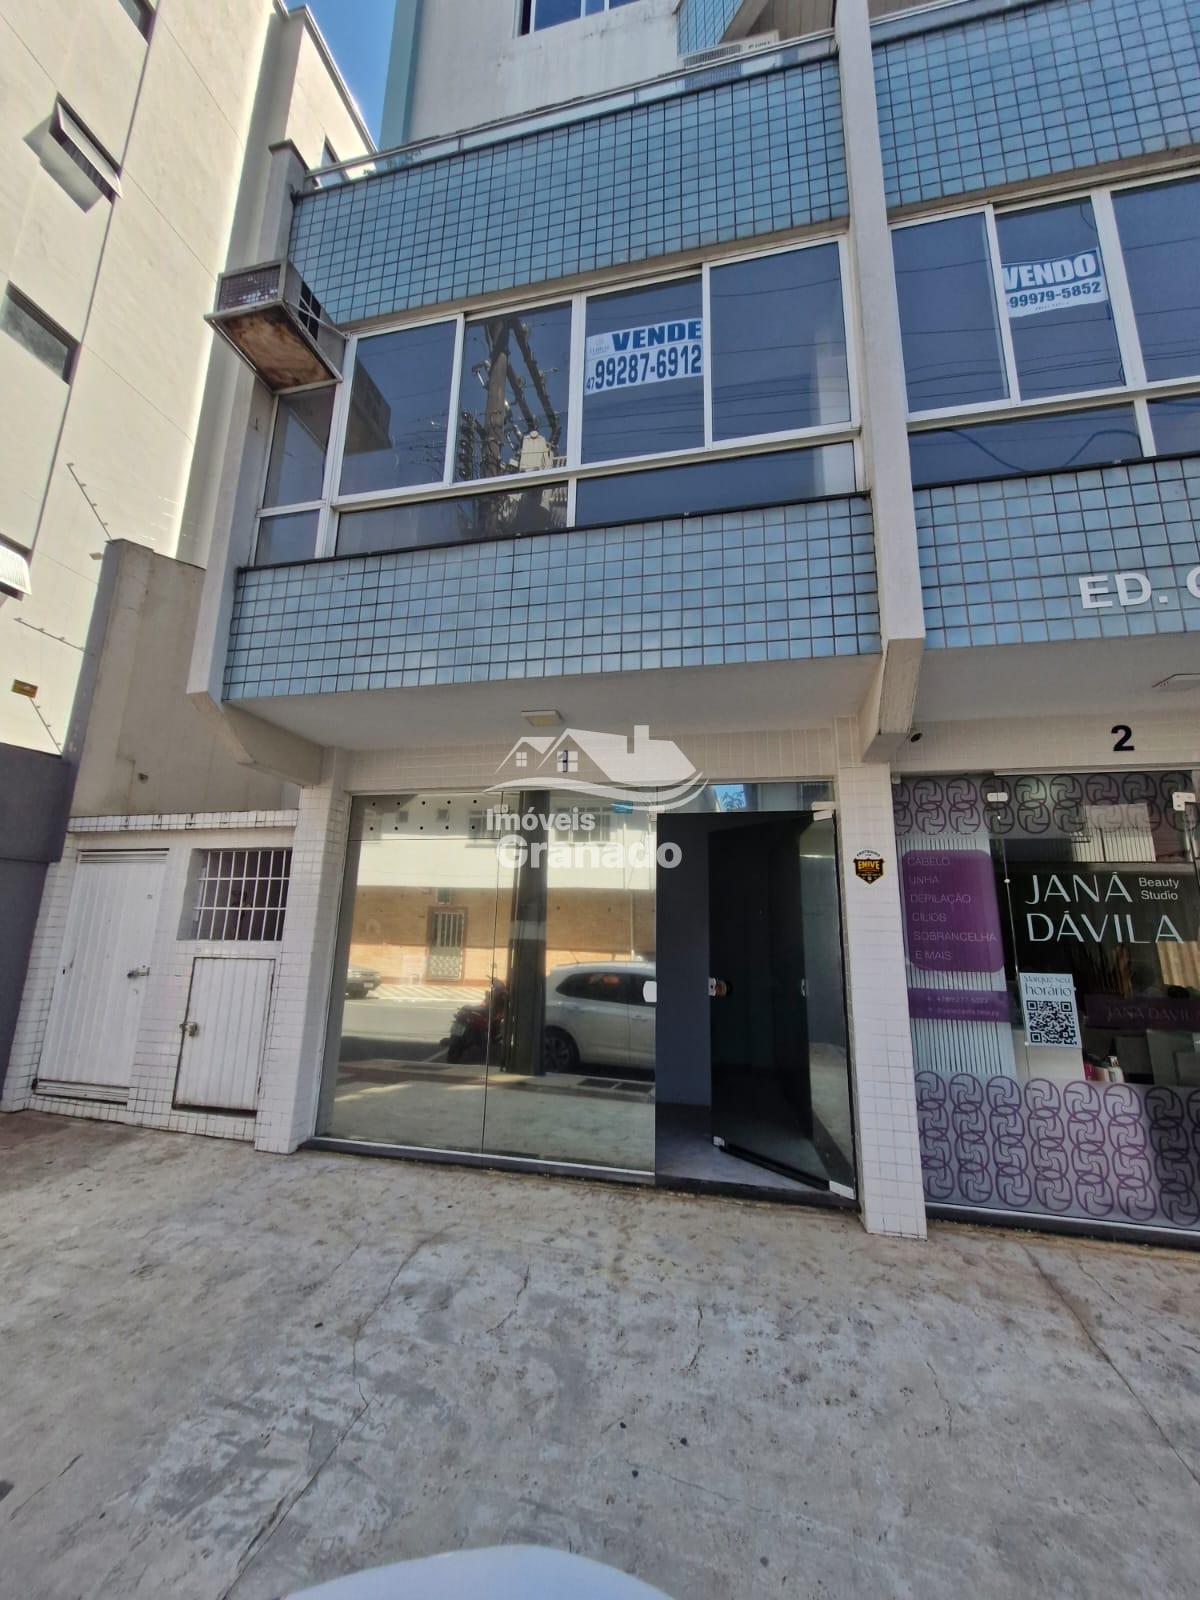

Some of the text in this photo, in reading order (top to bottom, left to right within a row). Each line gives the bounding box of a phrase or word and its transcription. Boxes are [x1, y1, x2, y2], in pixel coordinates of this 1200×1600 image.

[1002, 254, 1097, 290] VENDO
[612, 320, 702, 352] VENDE
[595, 344, 702, 390] 99287-6912
[1079, 572, 1169, 609] ED.
[1111, 724, 1135, 751] 2
[907, 856, 950, 866] CABELO
[908, 875, 939, 884] UNHA
[1138, 877, 1180, 889] Beauty
[1140, 889, 1179, 900] Studio
[913, 931, 998, 942] SOBRANCELHA
[924, 951, 953, 960] MAIS
[1024, 983, 1072, 996] horário
